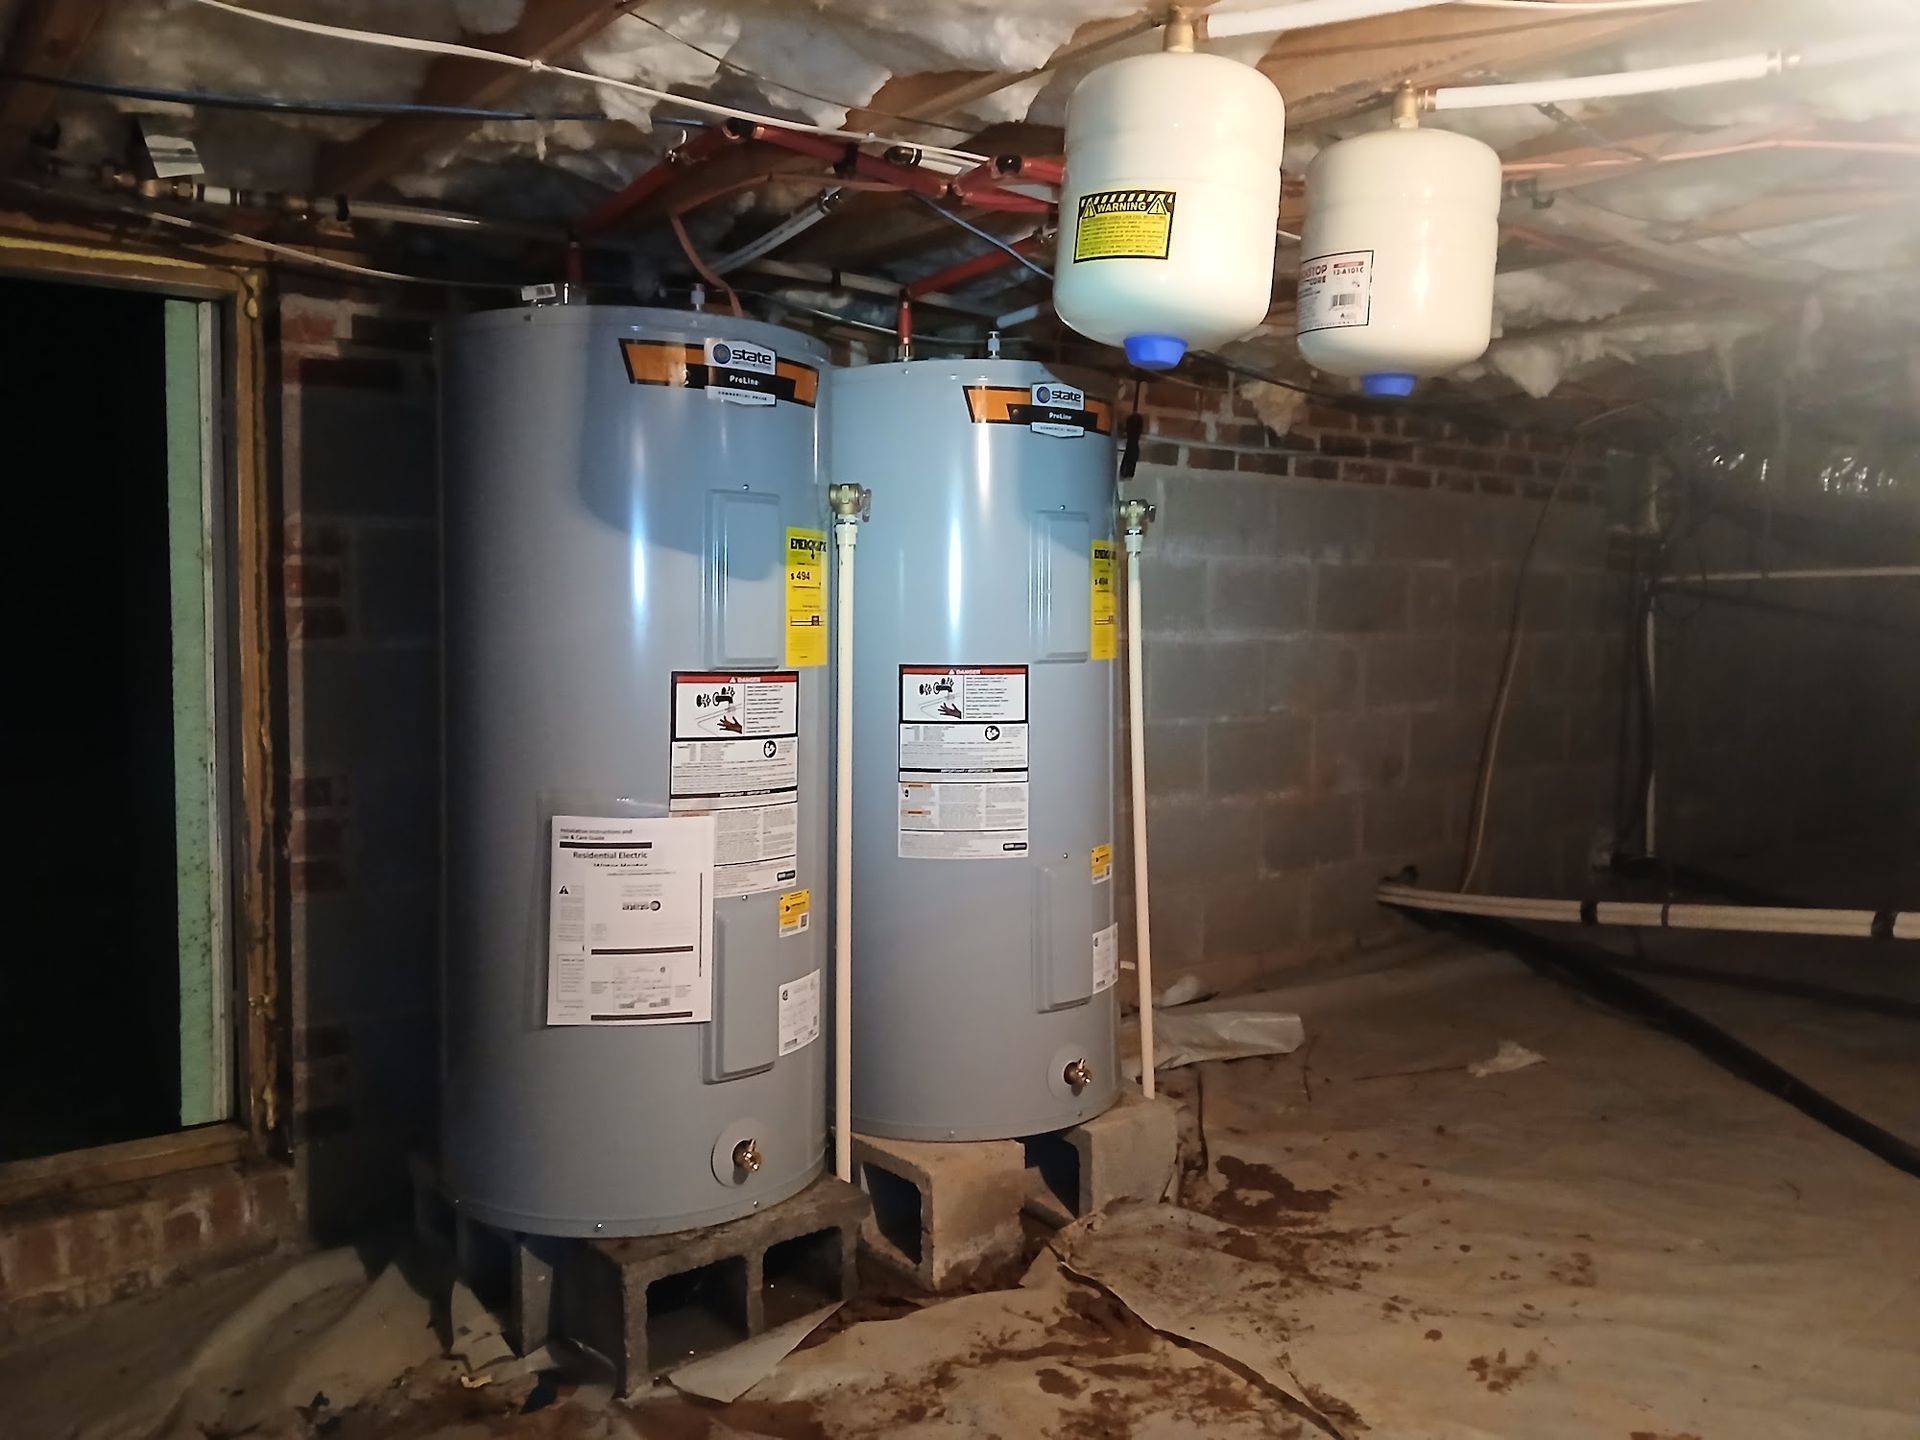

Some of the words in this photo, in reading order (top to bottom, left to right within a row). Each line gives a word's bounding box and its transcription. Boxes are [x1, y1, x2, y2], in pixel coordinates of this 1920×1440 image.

[1096, 201, 1147, 213] WARNING
[731, 349, 772, 366] state
[729, 374, 759, 386] ProLine
[1051, 390, 1082, 403] state
[1049, 411, 1072, 420] ProLine
[796, 571, 810, 581] 494
[573, 851, 617, 859] Residential
